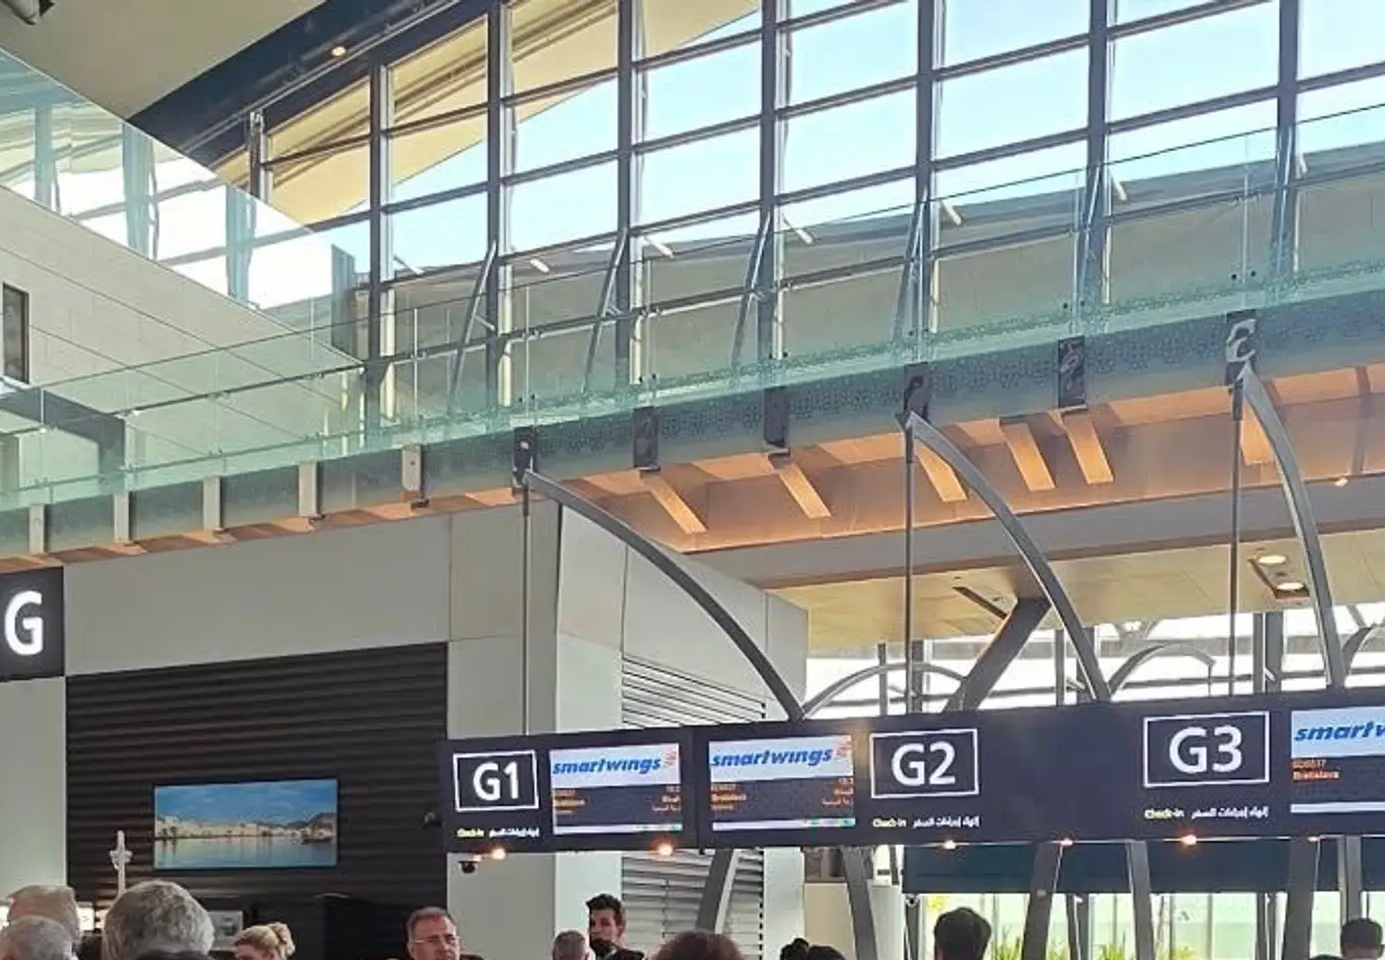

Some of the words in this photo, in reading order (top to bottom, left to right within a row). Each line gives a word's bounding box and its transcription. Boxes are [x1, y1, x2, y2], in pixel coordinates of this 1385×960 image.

[4, 591, 43, 655] G
[552, 757, 662, 775] smartwings
[710, 748, 833, 768] smartwings
[891, 741, 956, 786] G2
[1169, 725, 1242, 774] G3
[473, 761, 520, 801] G1
